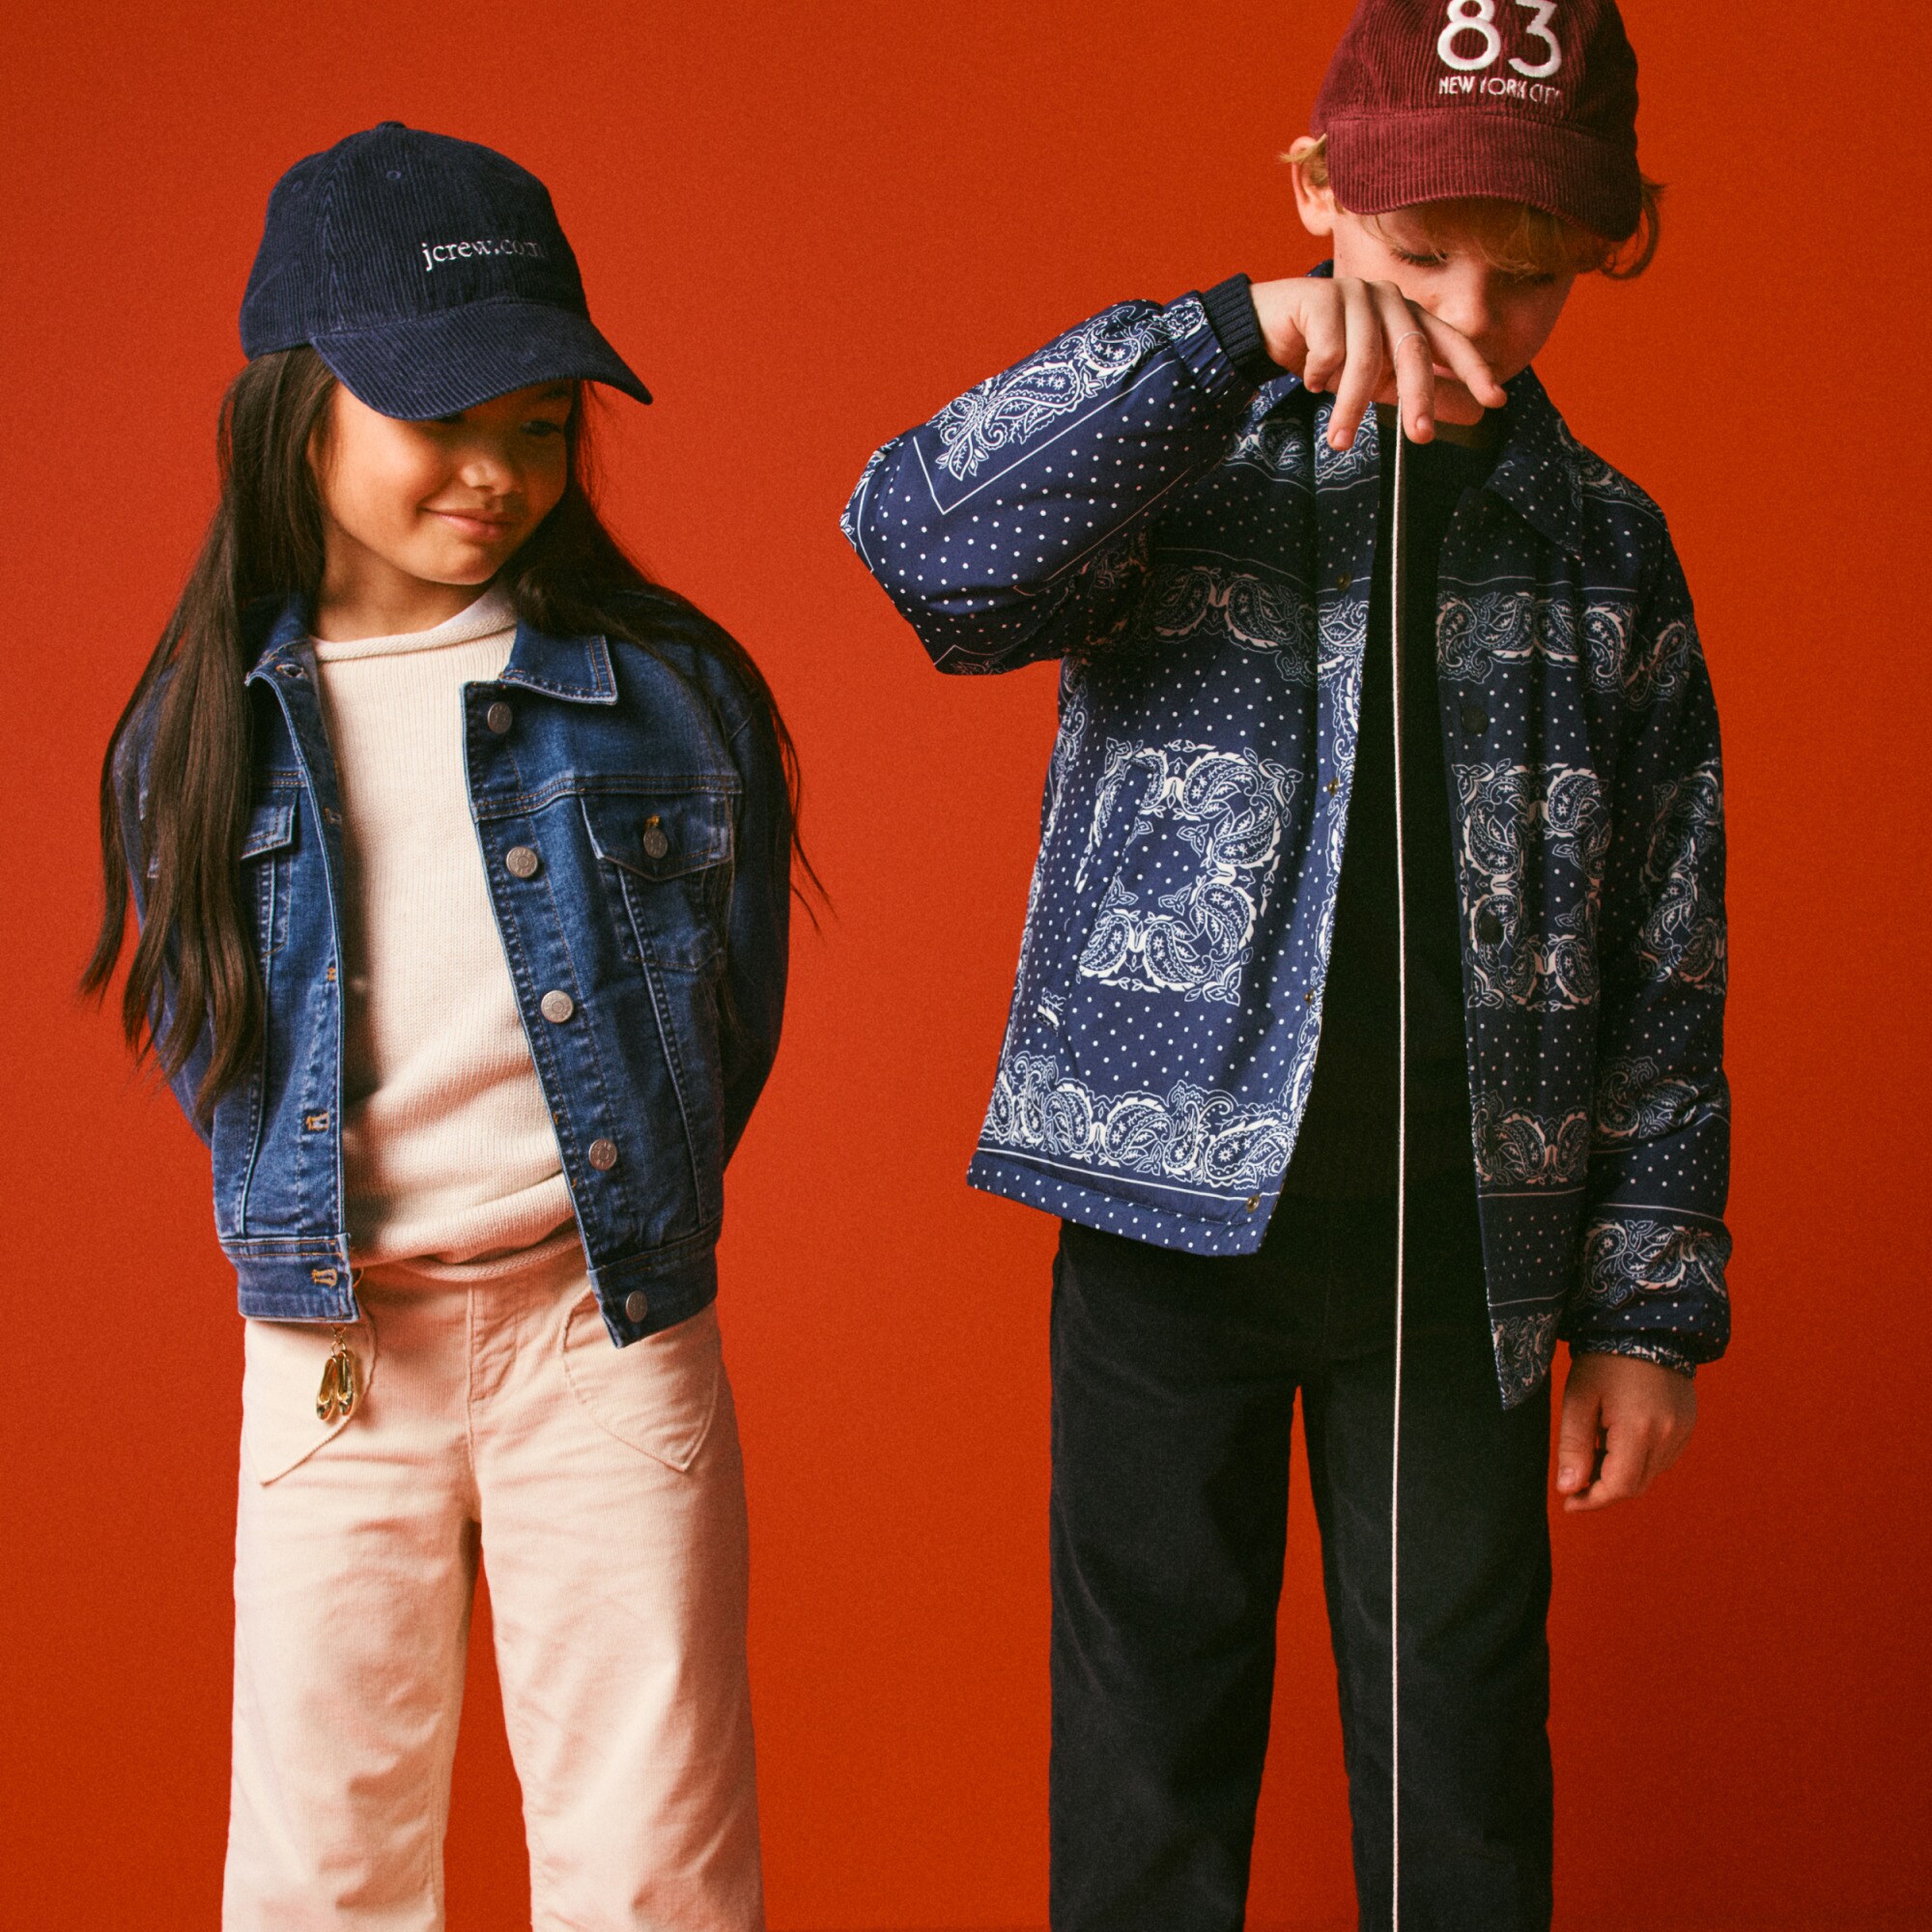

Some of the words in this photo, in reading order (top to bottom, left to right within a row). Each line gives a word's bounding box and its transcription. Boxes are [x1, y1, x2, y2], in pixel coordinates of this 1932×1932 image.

[1436, 0, 1562, 78] 83
[1438, 75, 1476, 95] NEW
[1479, 77, 1528, 99] YORK
